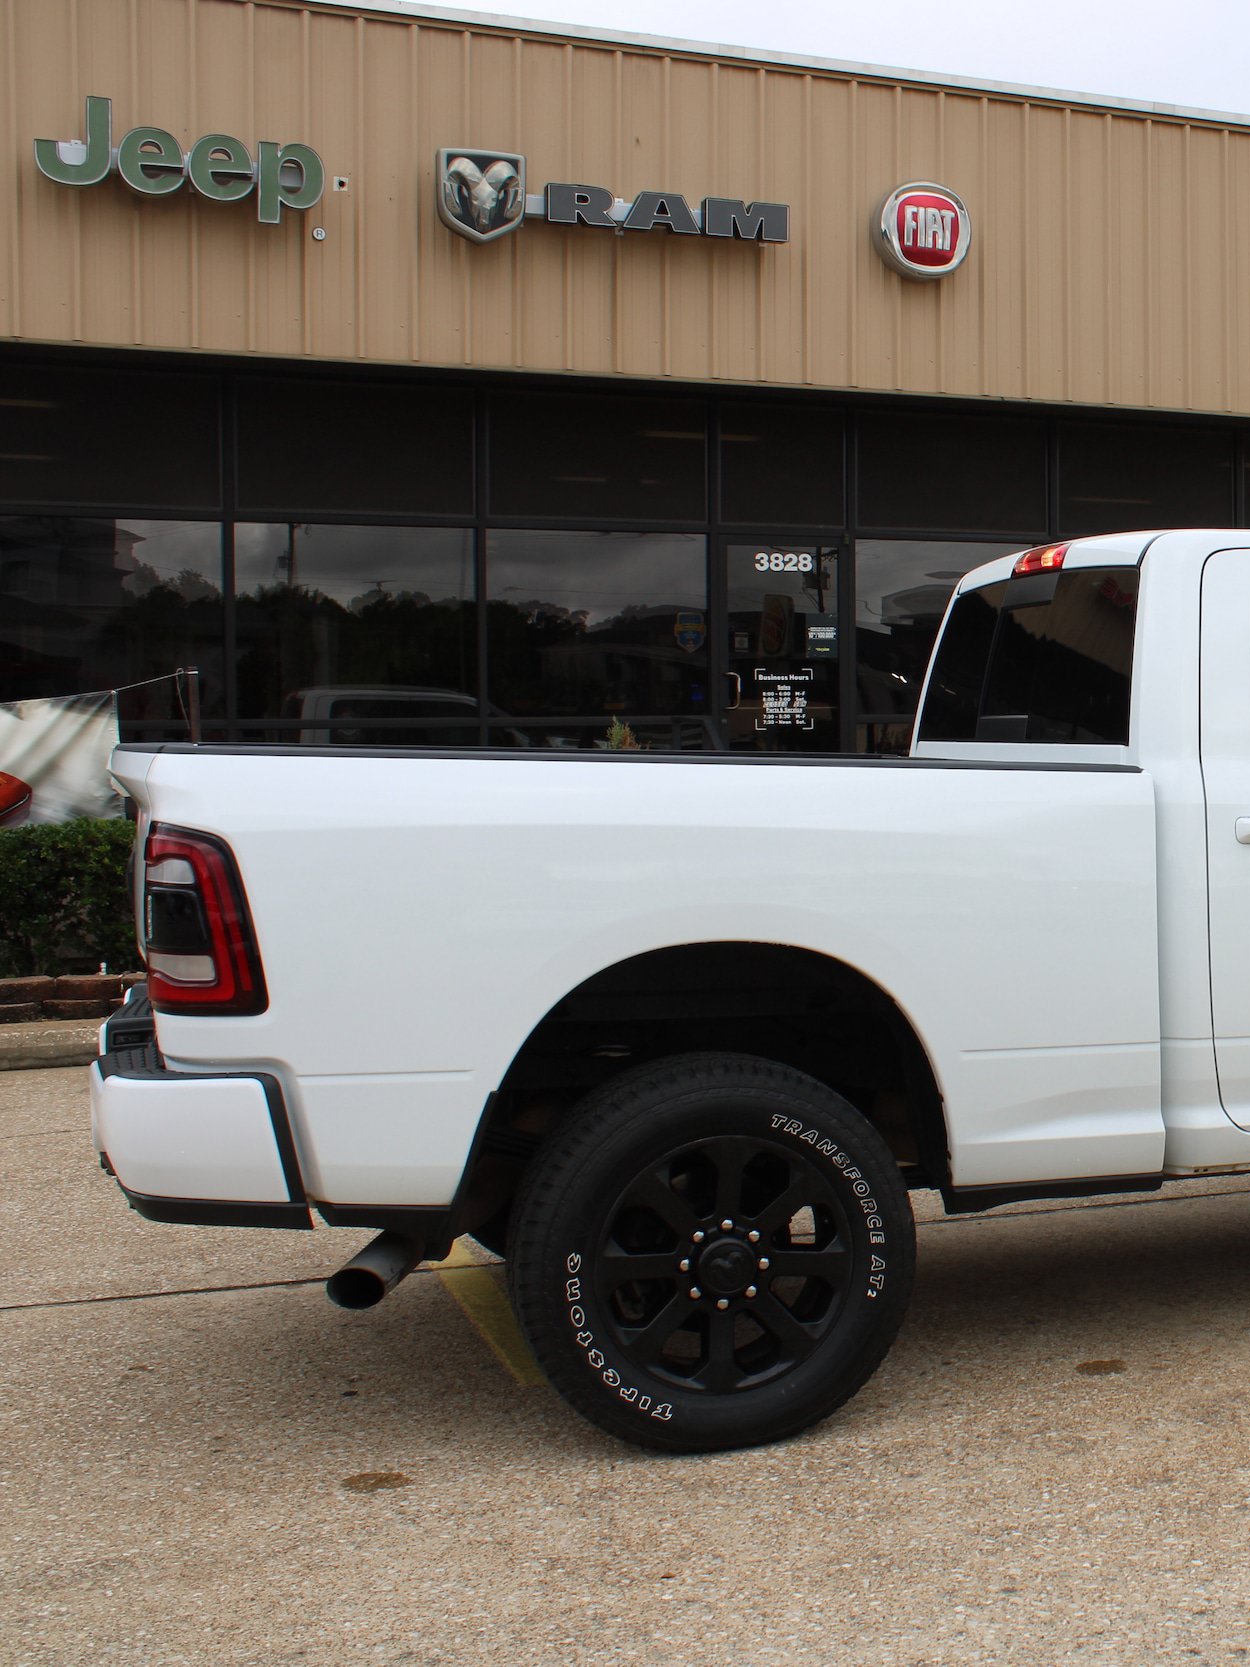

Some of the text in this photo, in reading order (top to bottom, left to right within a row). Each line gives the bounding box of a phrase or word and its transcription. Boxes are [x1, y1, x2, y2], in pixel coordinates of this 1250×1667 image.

[33, 95, 325, 225] Jeep
[544, 182, 791, 244] RAM
[904, 205, 955, 251] FIAT
[755, 553, 812, 572] 3828
[771, 1113, 886, 1245] TRANSFORCE
[565, 1252, 673, 1421] Firestone
